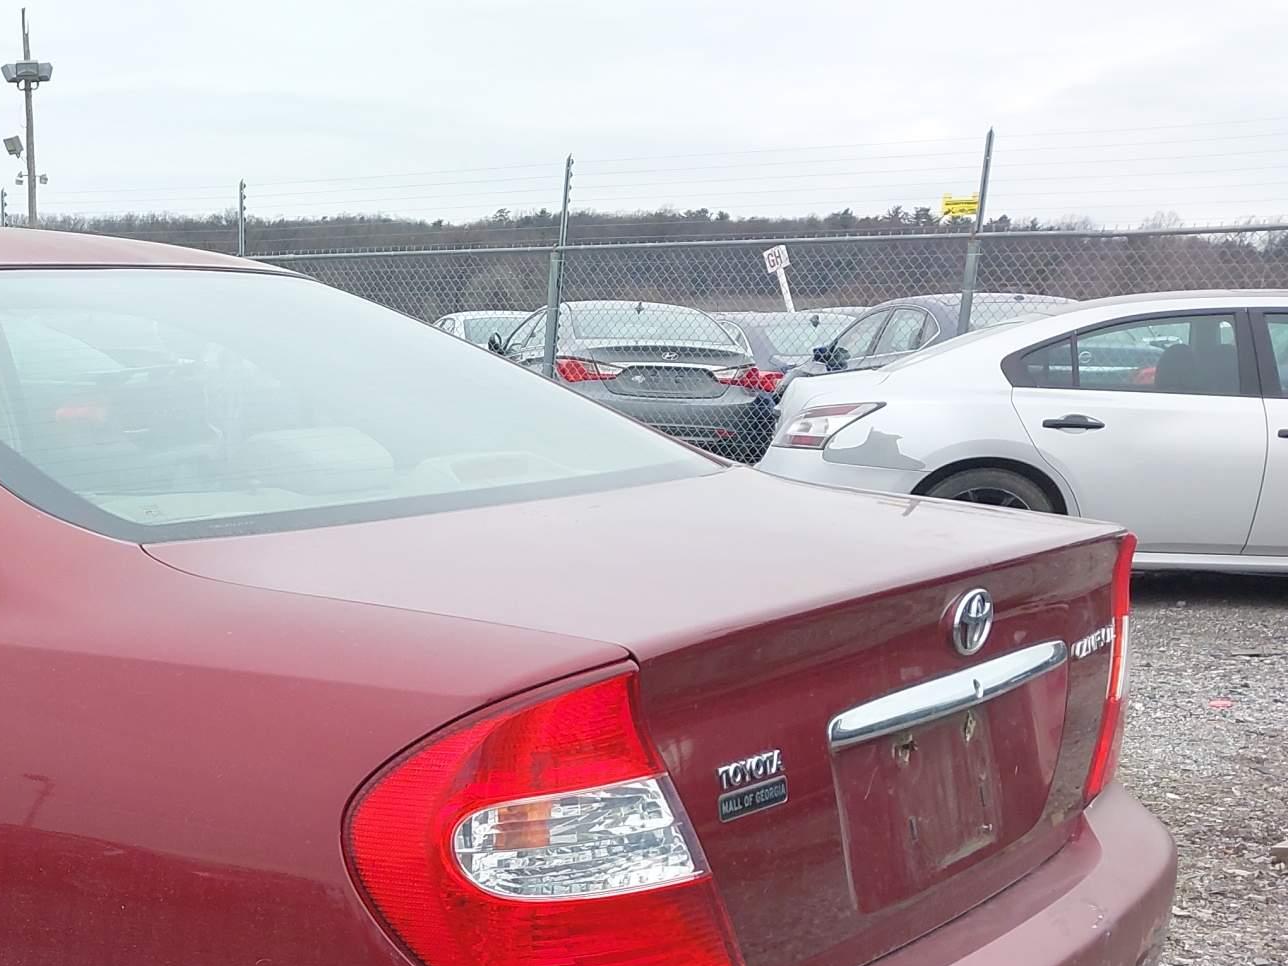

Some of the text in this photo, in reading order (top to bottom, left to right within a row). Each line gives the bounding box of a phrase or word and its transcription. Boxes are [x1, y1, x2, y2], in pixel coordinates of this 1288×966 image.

[767, 248, 783, 268] GH
[718, 748, 786, 790] TOYOTA
[722, 783, 787, 816] MALL OF GEORGIA
